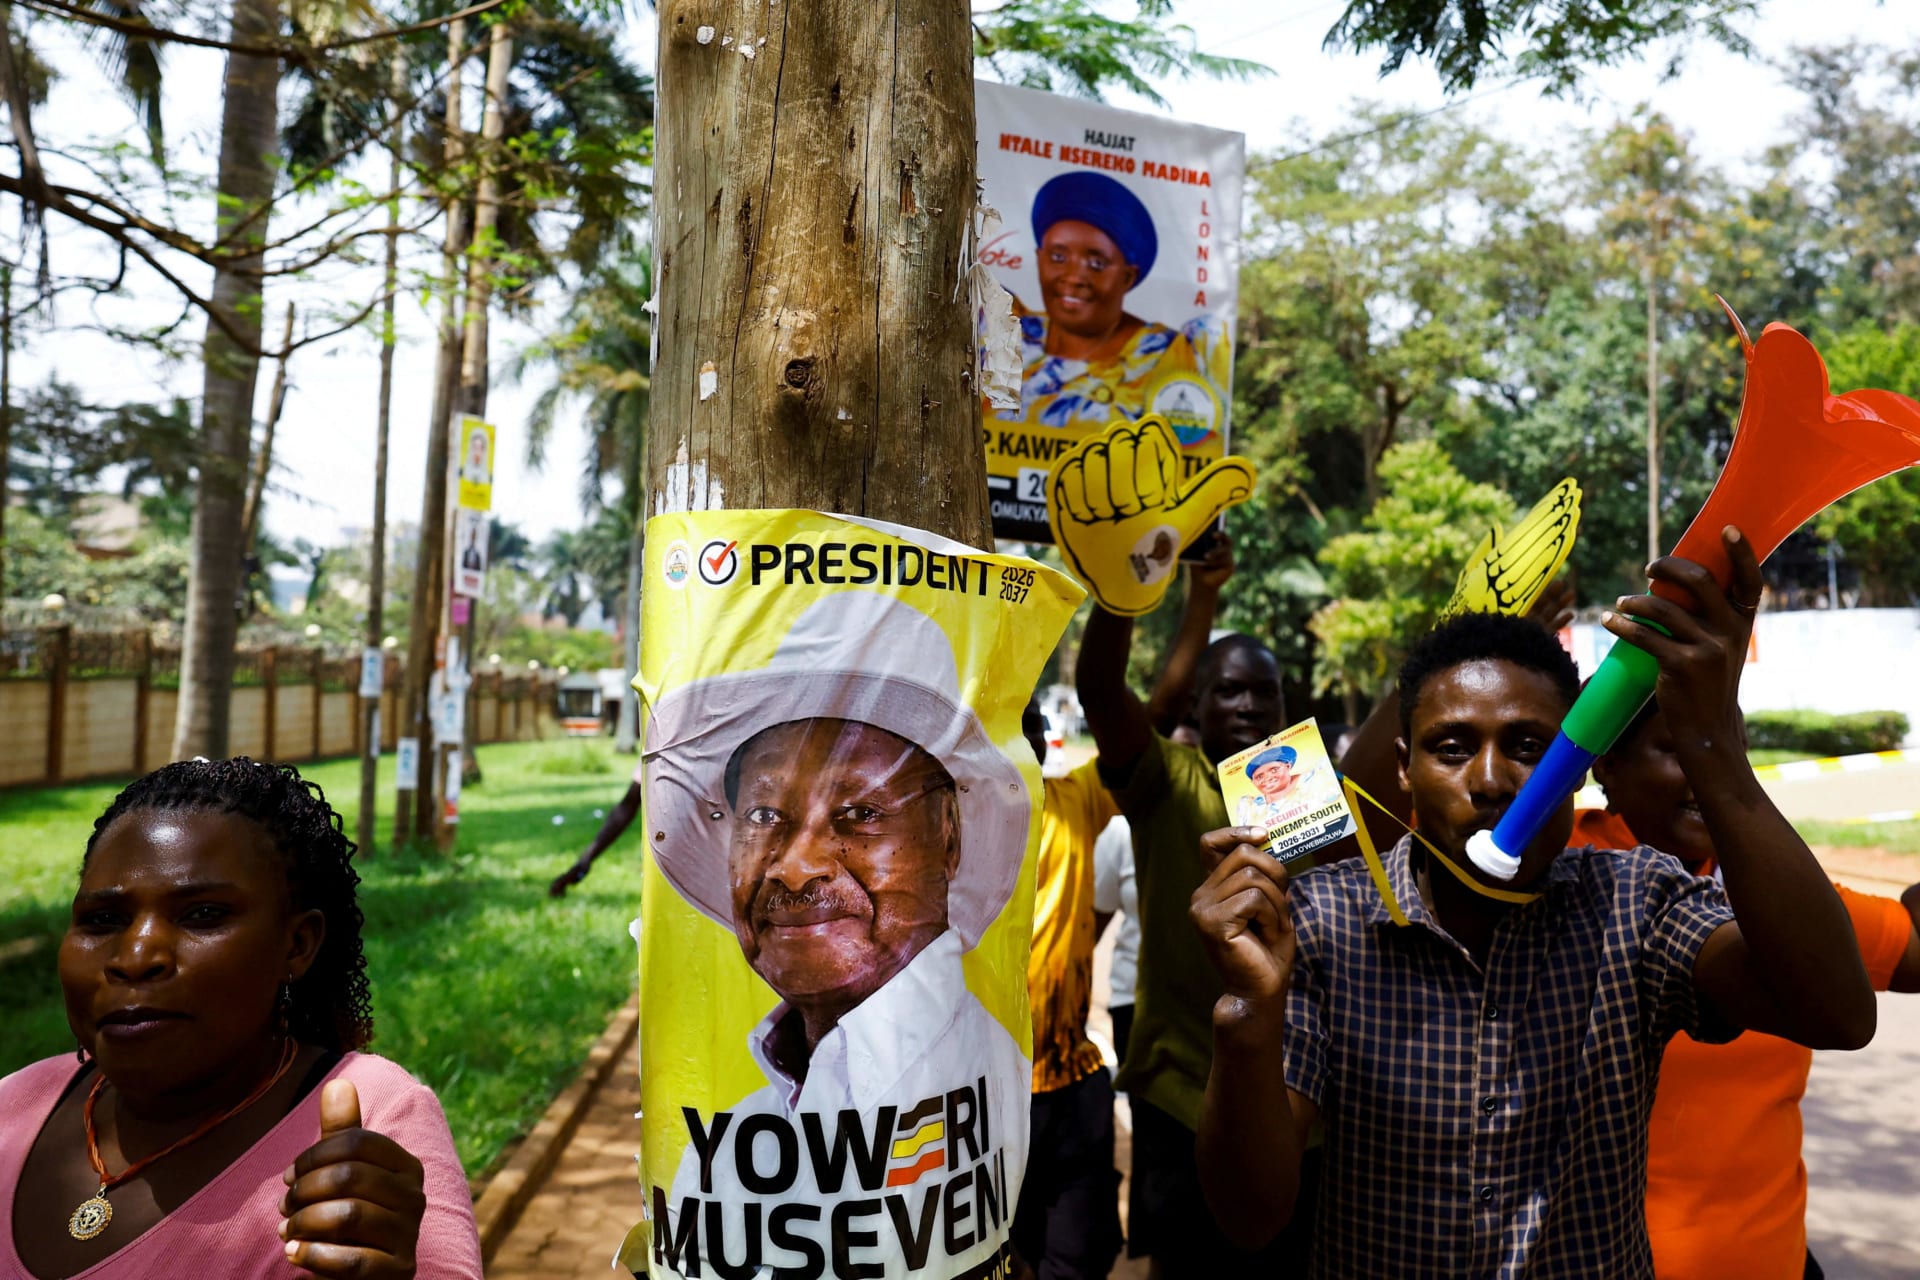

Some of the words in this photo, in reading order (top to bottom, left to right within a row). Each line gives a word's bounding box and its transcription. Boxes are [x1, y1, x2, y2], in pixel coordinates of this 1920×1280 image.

[999, 133, 1054, 159] NTALE
[1059, 145, 1136, 175] NSEREKO
[1142, 160, 1211, 188] MADINA
[1084, 129, 1136, 152] HAJJAT
[1194, 199, 1210, 307] LONDA
[751, 542, 995, 597] PRESIDENT
[1001, 566, 1037, 587] 2026
[1265, 803, 1309, 828] SECURITY
[1310, 802, 1342, 822] SOUTH
[1278, 826, 1320, 850] 2026-2031
[681, 1075, 990, 1194] YOWERI
[653, 1146, 1009, 1280] MUSEVENI
